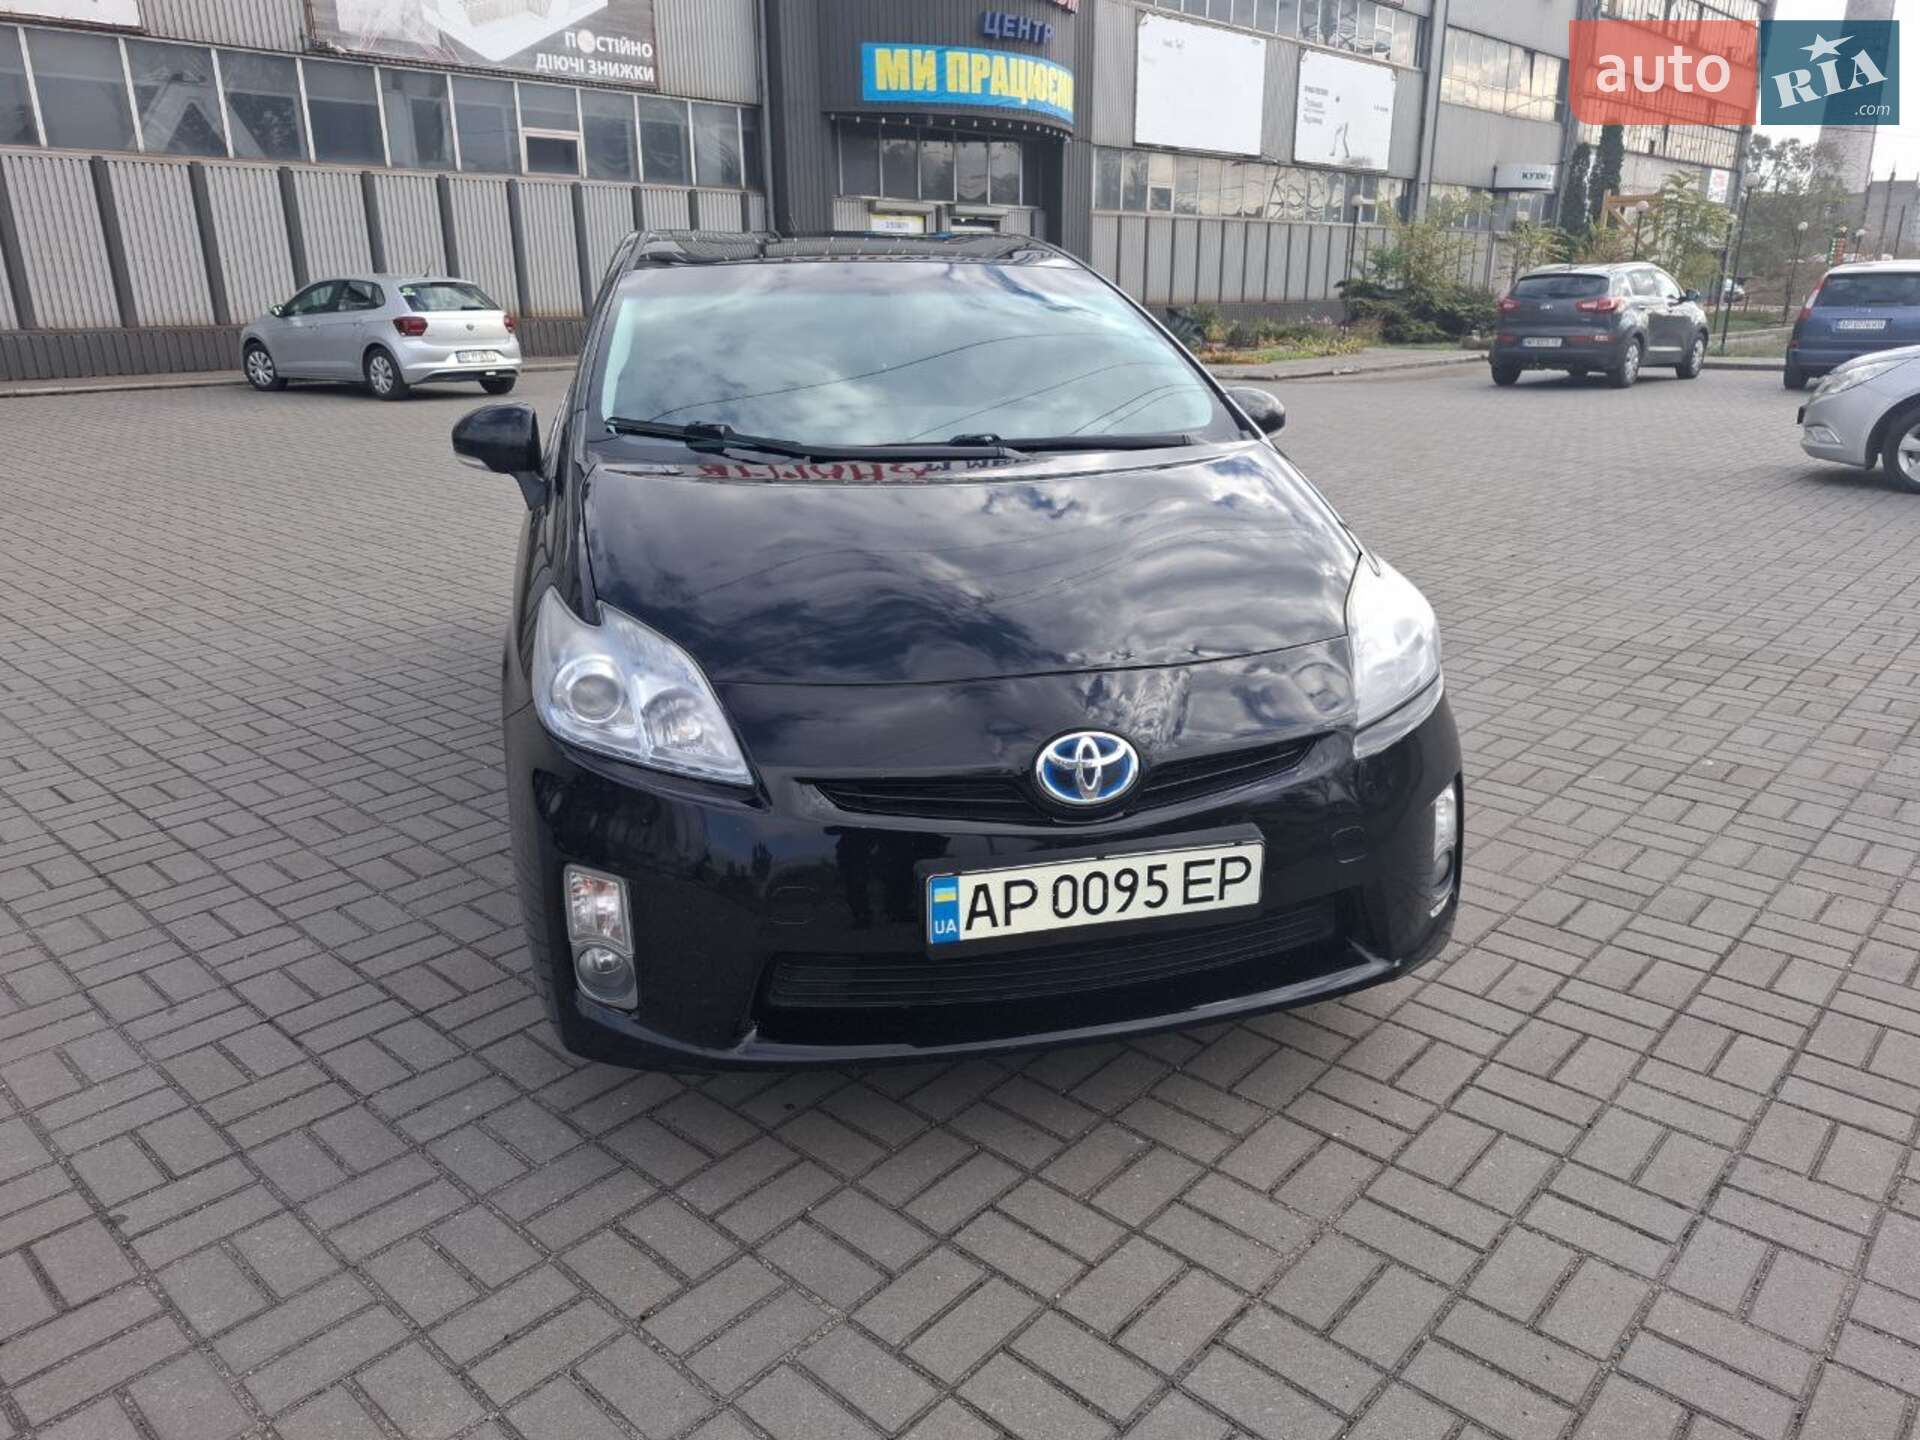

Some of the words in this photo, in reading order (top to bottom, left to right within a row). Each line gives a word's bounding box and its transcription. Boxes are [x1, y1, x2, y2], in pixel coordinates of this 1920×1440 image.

[984, 12, 1056, 44] ЦЕНТР
[535, 52, 585, 74] ДІЮЧІ
[587, 59, 655, 83] ЗНИЖКИ
[874, 48, 937, 92] МИ
[964, 878, 1039, 931] AP
[1052, 863, 1169, 919] 0095
[1182, 855, 1253, 906] EP
[934, 919, 958, 935] UA
